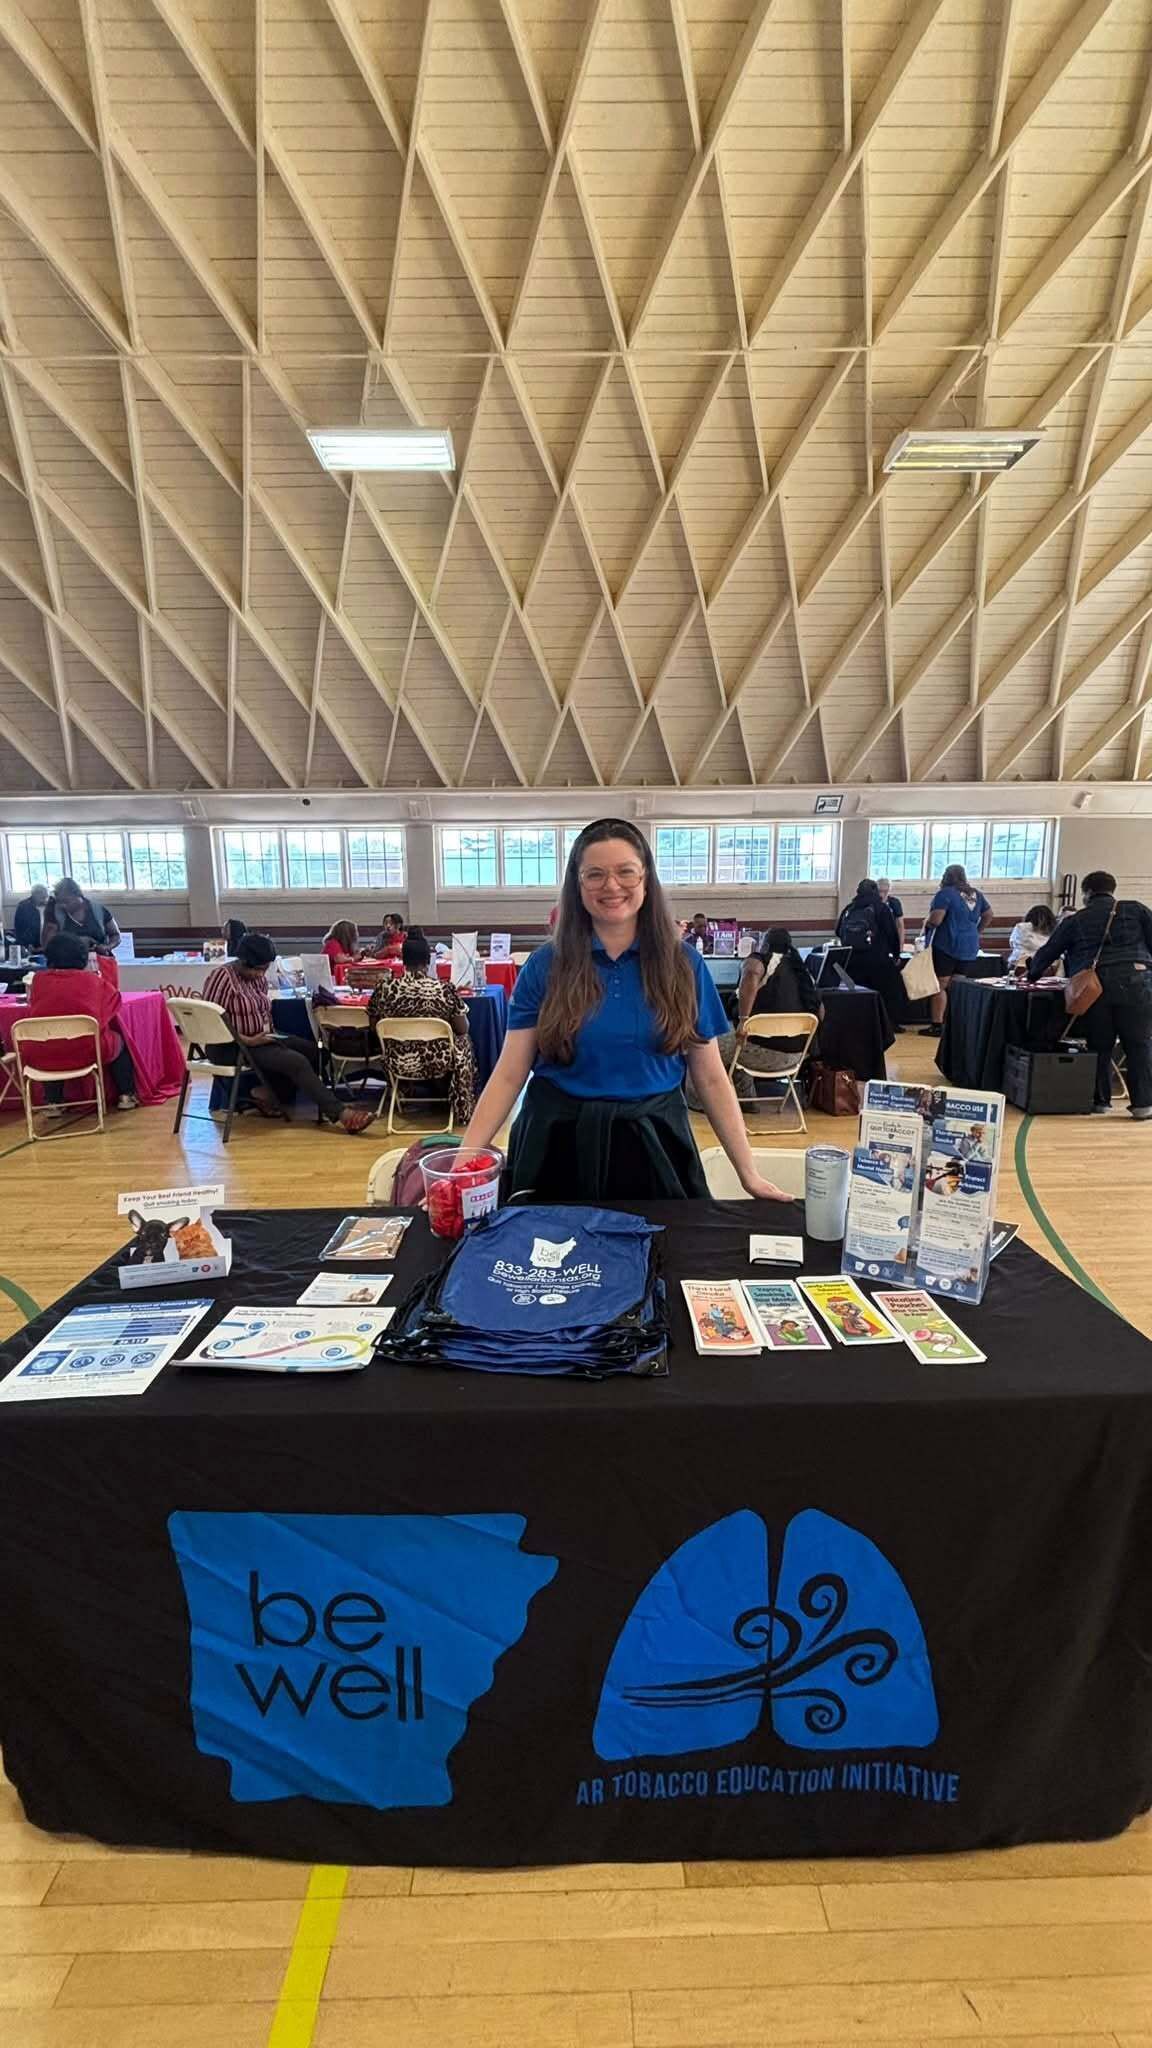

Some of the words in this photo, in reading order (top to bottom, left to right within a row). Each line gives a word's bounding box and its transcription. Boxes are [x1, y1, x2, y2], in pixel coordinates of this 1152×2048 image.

[972, 1104, 984, 1112] USE
[492, 1268, 601, 1283] bewellarkansas.org
[494, 1260, 602, 1278] 833-283-WELL
[249, 1570, 386, 1653] be
[234, 1646, 424, 1722] well
[576, 1779, 604, 1806] AR
[612, 1770, 708, 1800] TOBACCO
[715, 1764, 834, 1795] EDUCATION
[841, 1761, 960, 1802] INITIATIVE
